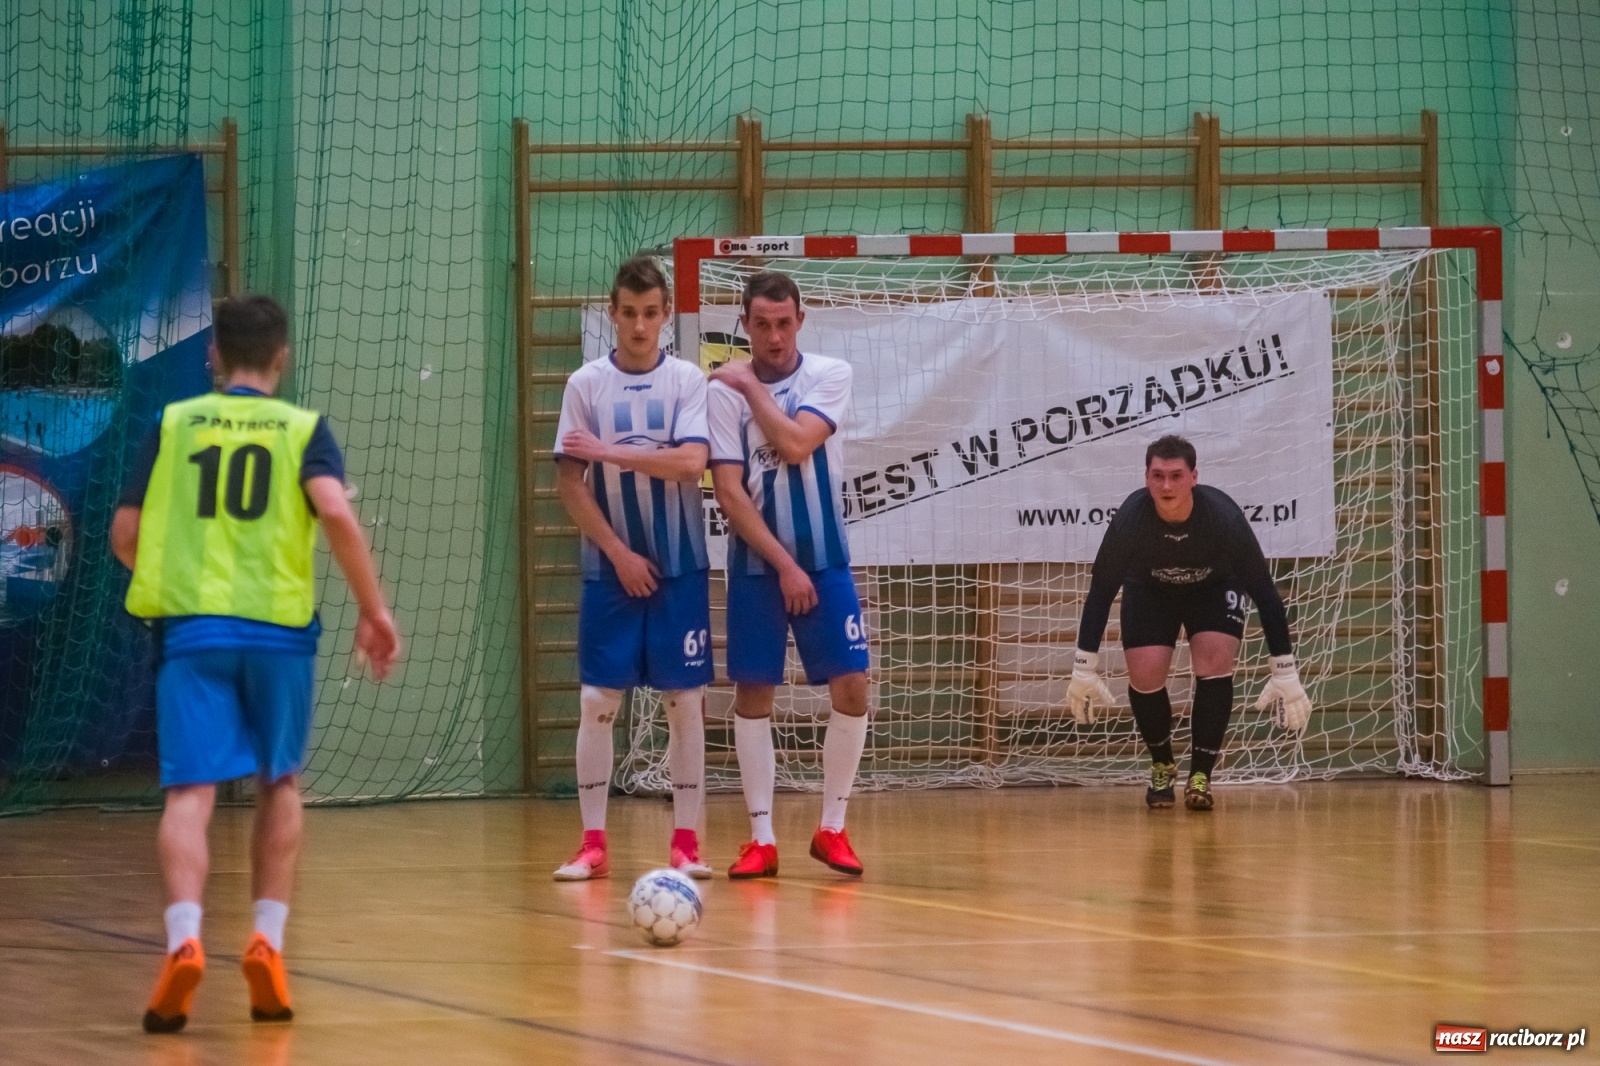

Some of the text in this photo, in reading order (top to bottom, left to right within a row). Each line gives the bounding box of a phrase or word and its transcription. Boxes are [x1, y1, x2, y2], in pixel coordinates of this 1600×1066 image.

[757, 241, 789, 253] sport
[211, 417, 288, 431] PATRICK
[841, 333, 1289, 520] JEST W PORZĄDKU!
[187, 444, 272, 521] 10
